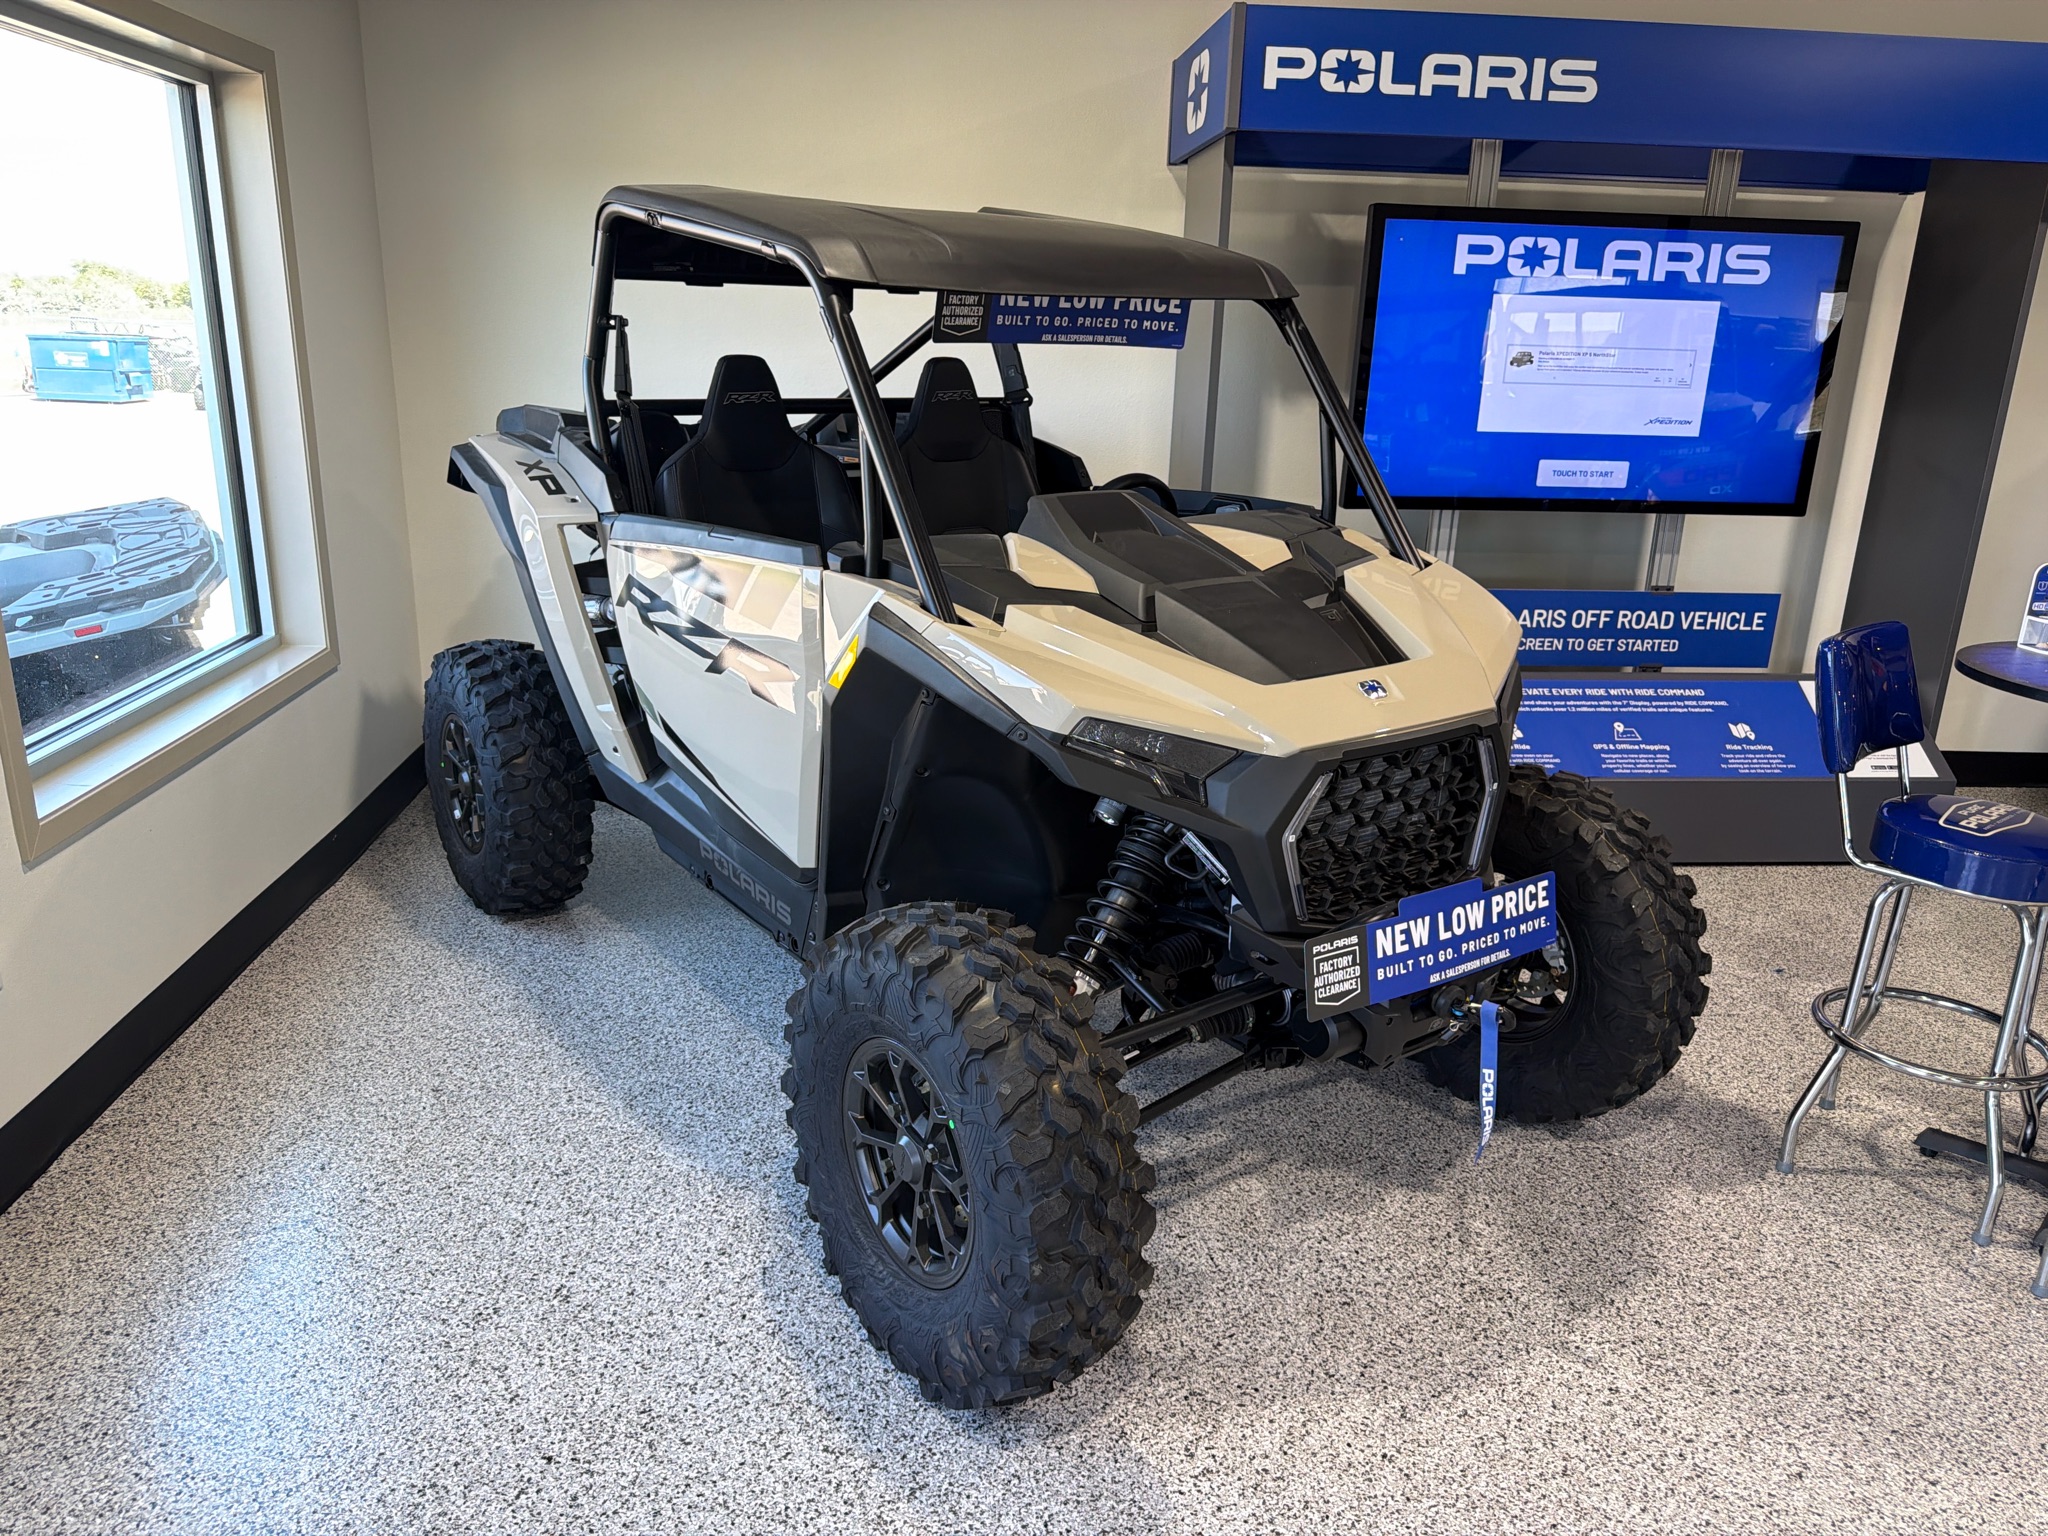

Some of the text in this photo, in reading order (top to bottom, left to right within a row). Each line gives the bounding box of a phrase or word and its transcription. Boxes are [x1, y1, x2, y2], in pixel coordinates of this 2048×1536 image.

[1263, 45, 1598, 103] POLARIS
[1453, 233, 1771, 285] POLARIS
[948, 294, 979, 305] FACTORY
[942, 306, 984, 316] AUTHORIZED
[944, 316, 979, 326] CLEARANCE
[996, 315, 1179, 332] BUILT TO GO. PRICED TO MOVE.
[1041, 333, 1052, 341] ASK
[1057, 334, 1094, 343] SALESPERSON
[1094, 335, 1105, 343] FOR
[1105, 335, 1128, 344] DETAILS.
[723, 391, 776, 405] RZR
[514, 458, 567, 496] XP
[1552, 469, 1577, 477] TOUCH
[1589, 470, 1614, 478] START
[1571, 609, 1614, 629] OFF
[1616, 610, 1675, 630] ROAD
[1680, 611, 1767, 631] VEHICLE
[616, 573, 800, 714] RZR
[1566, 638, 1584, 651] TO
[1587, 638, 1615, 651] GET
[1617, 639, 1679, 652] STARTED
[1552, 688, 1583, 696] EVERY
[1584, 688, 1608, 696] RIDE
[1608, 688, 1633, 696] WITH
[1634, 688, 1657, 696] RIDE
[1657, 688, 1705, 697] COMMAND
[699, 839, 791, 926] POLARIS
[1375, 879, 1549, 959] NEW LOW PRICE
[1312, 935, 1359, 955] POLARIS
[1377, 916, 1551, 981] BUILT TO GO. PRICED TO MOVE.
[1319, 954, 1353, 974] FACTORY
[1429, 948, 1512, 984] ASK A SALESPERSON FOR DETAILS.
[1314, 965, 1361, 989] AUTHORIZED
[1318, 978, 1358, 999] CLEARANCE
